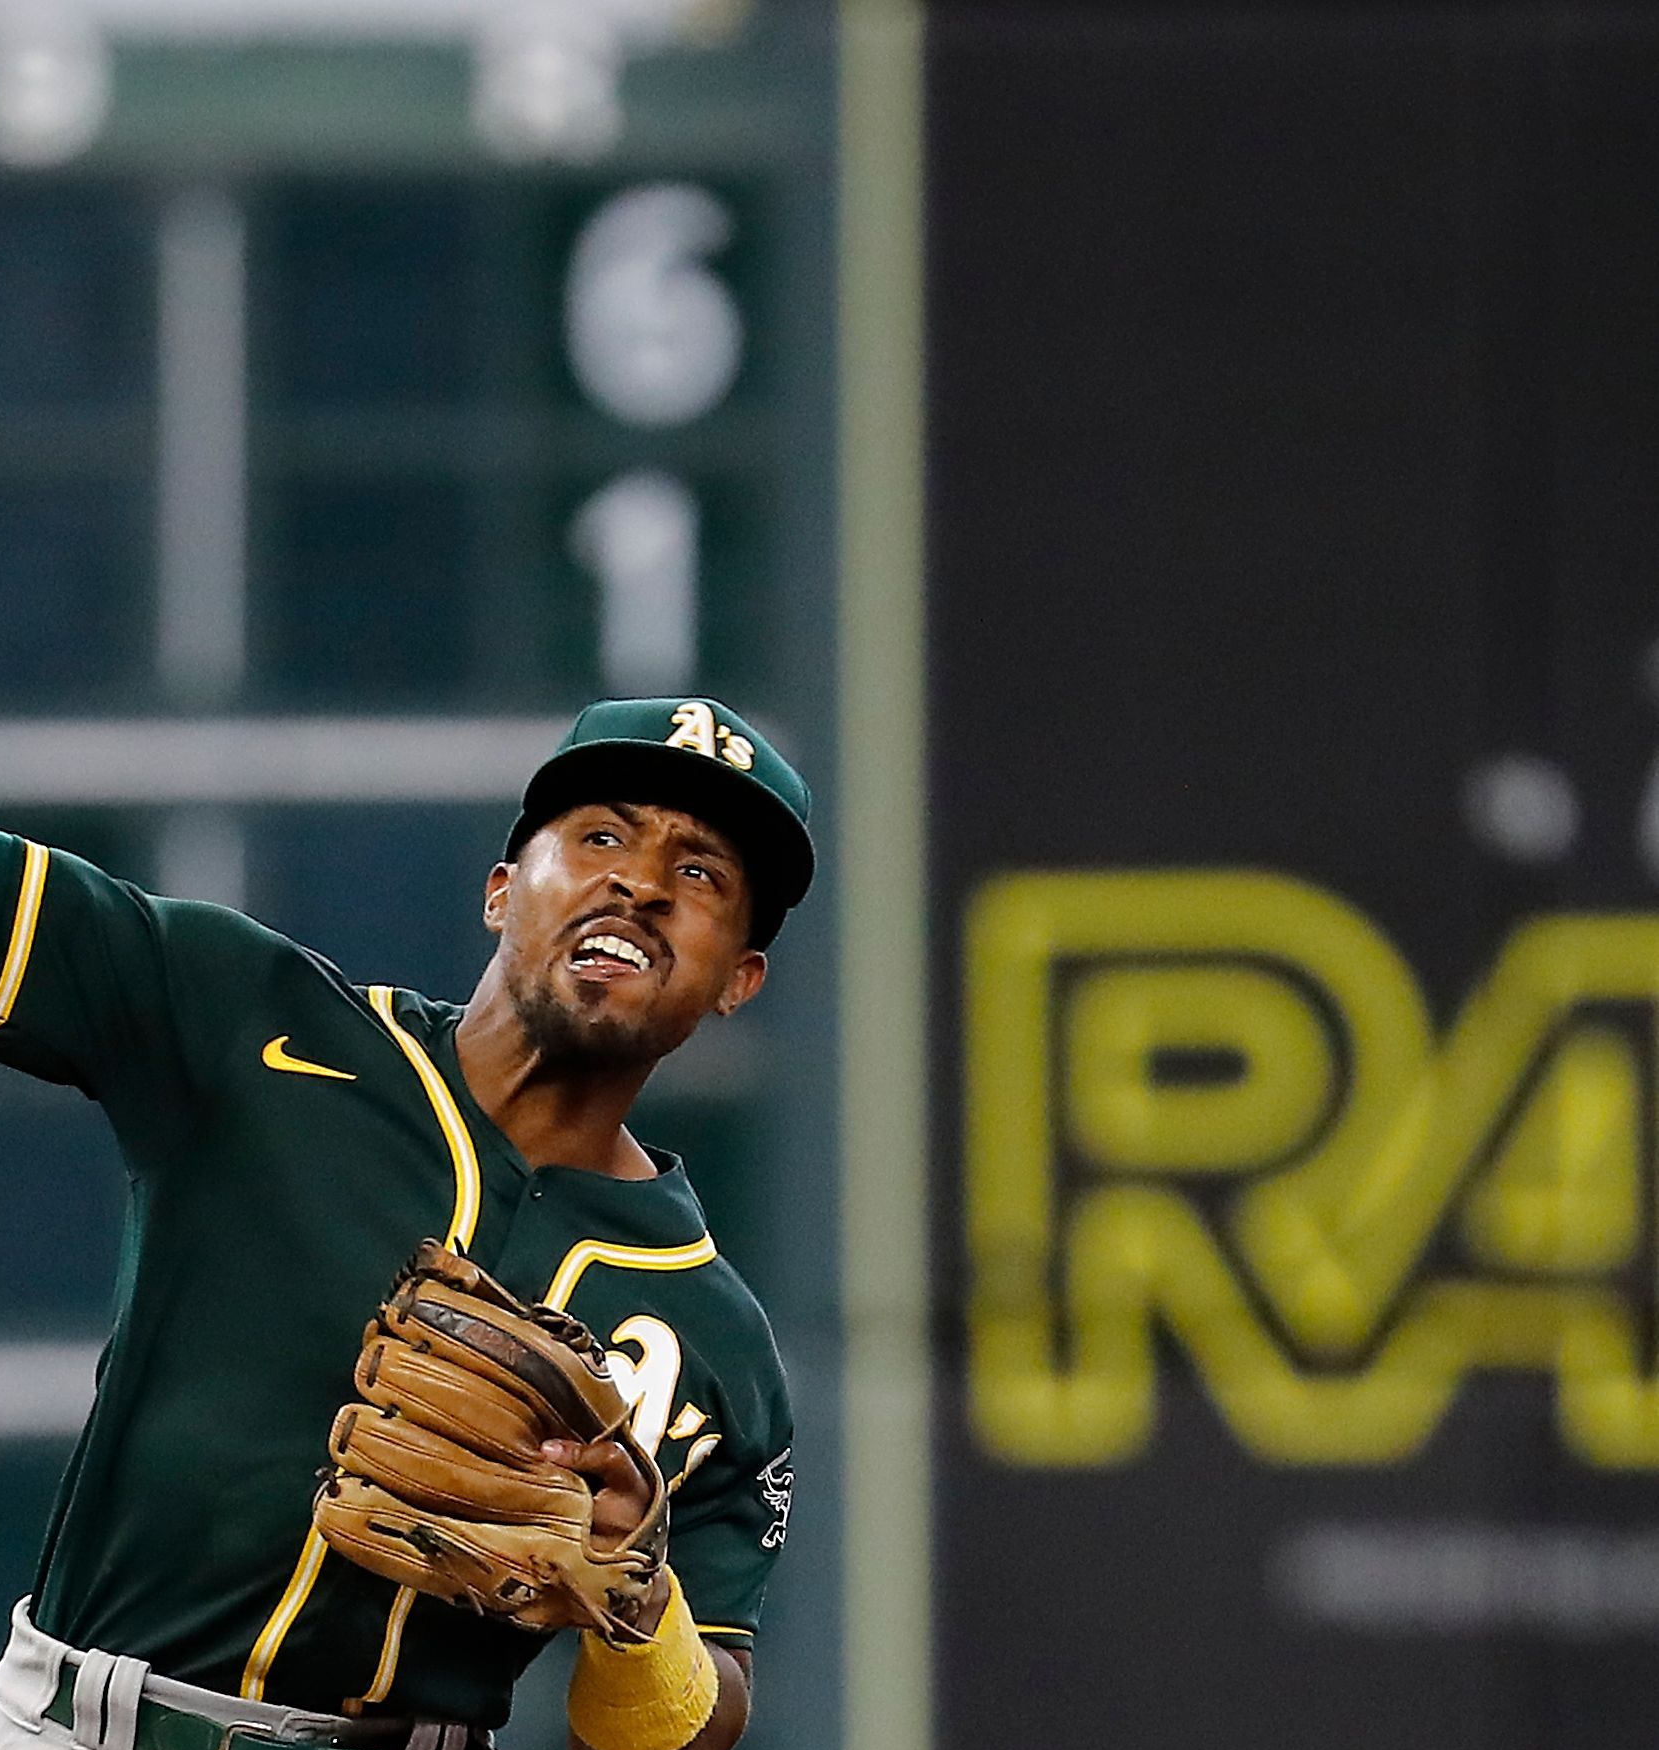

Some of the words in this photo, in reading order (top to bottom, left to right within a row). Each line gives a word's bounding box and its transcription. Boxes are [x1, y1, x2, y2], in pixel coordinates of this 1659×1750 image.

[564, 184, 742, 430] 6
[572, 472, 700, 692] 1
[664, 700, 756, 772] A's
